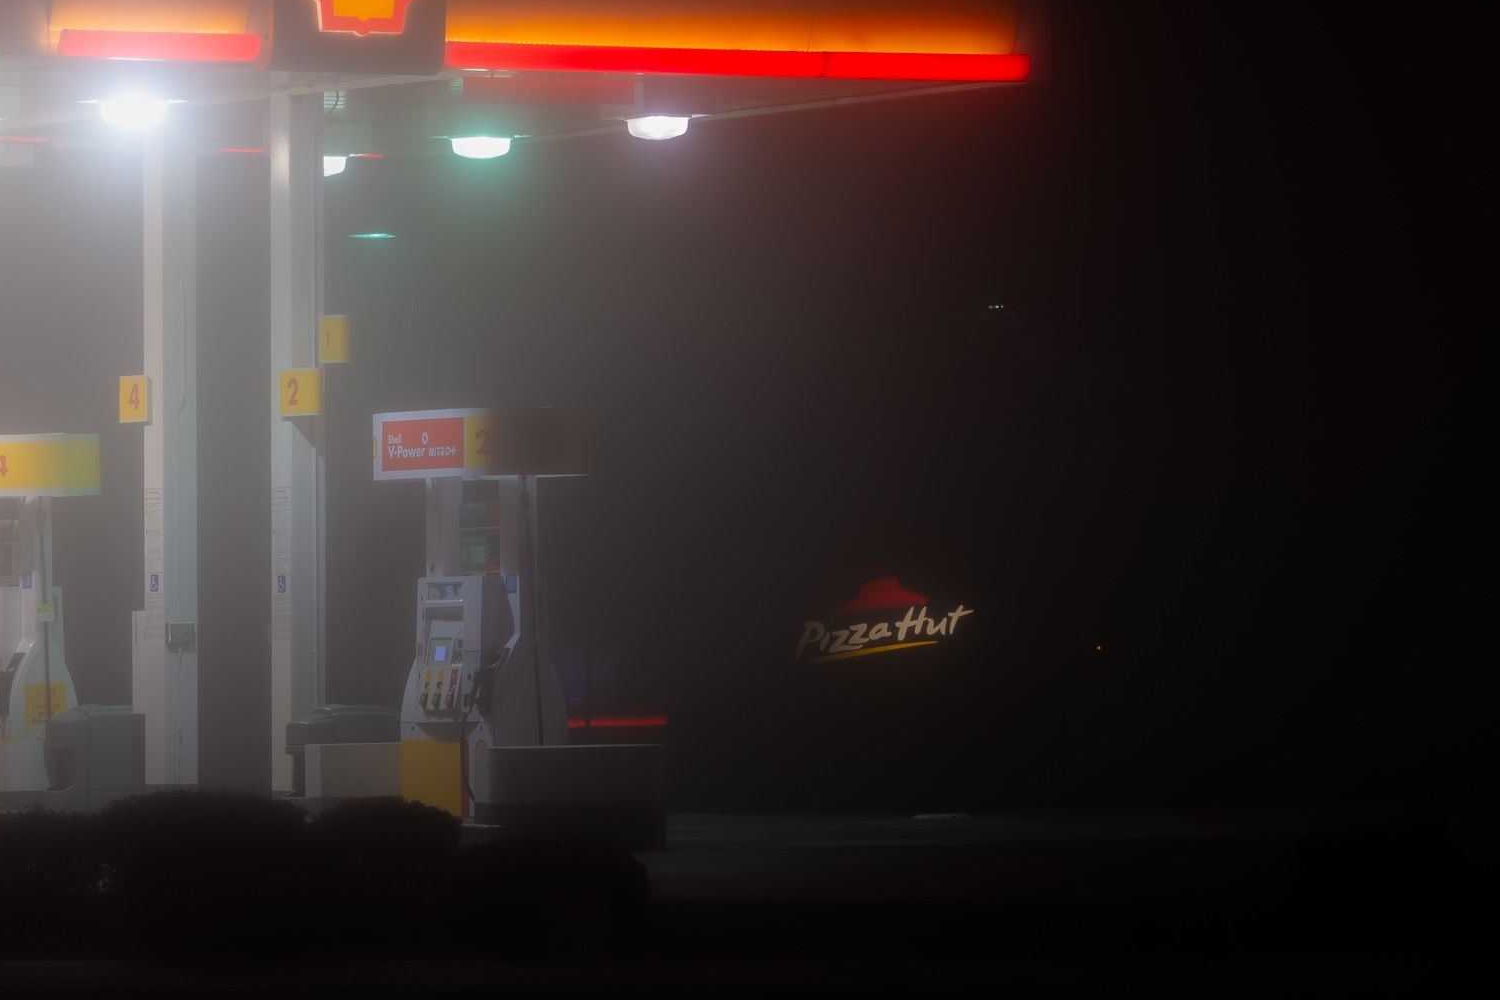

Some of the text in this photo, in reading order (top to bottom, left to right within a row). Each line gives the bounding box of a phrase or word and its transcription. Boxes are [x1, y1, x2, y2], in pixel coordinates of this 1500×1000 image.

[128, 383, 141, 411] 4
[287, 378, 299, 406] 2
[387, 445, 426, 459] V-Power
[795, 604, 974, 660] Pizza Hut
